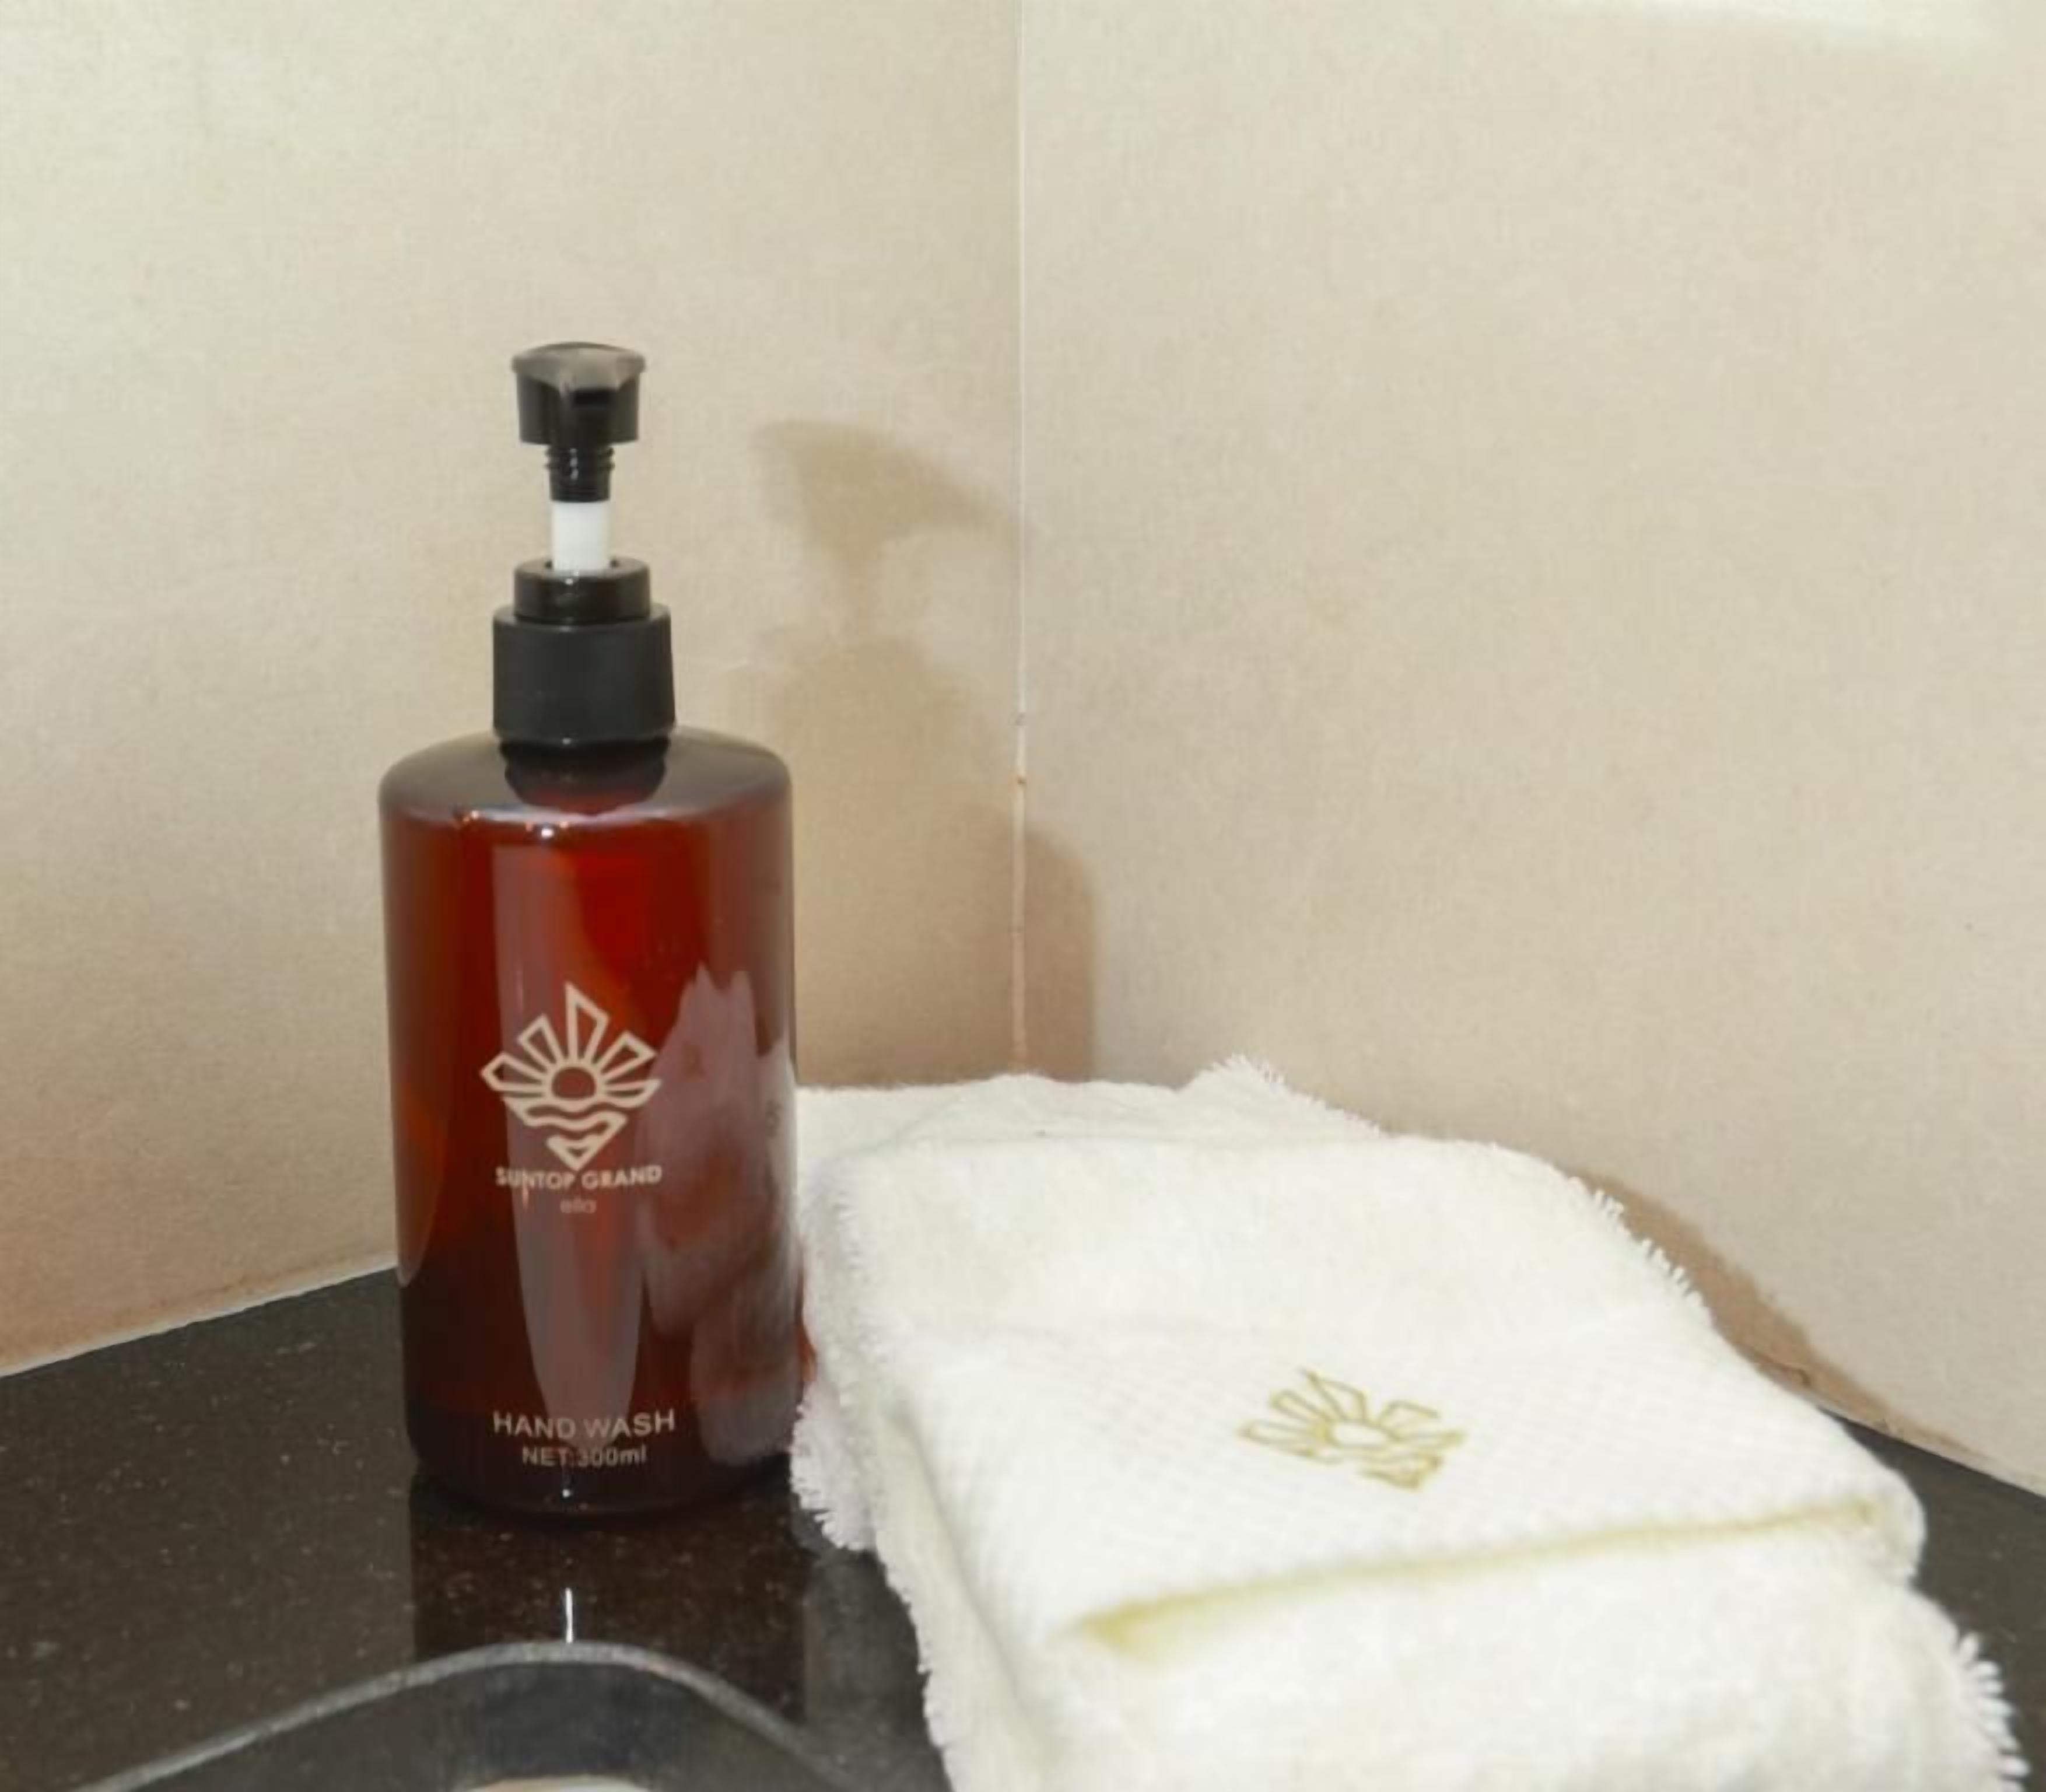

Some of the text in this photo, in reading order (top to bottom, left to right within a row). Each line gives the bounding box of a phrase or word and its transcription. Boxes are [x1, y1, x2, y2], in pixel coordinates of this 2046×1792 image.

[496, 1164, 661, 1189] SUNTOP GRAND
[493, 1408, 674, 1439] HAND WASH
